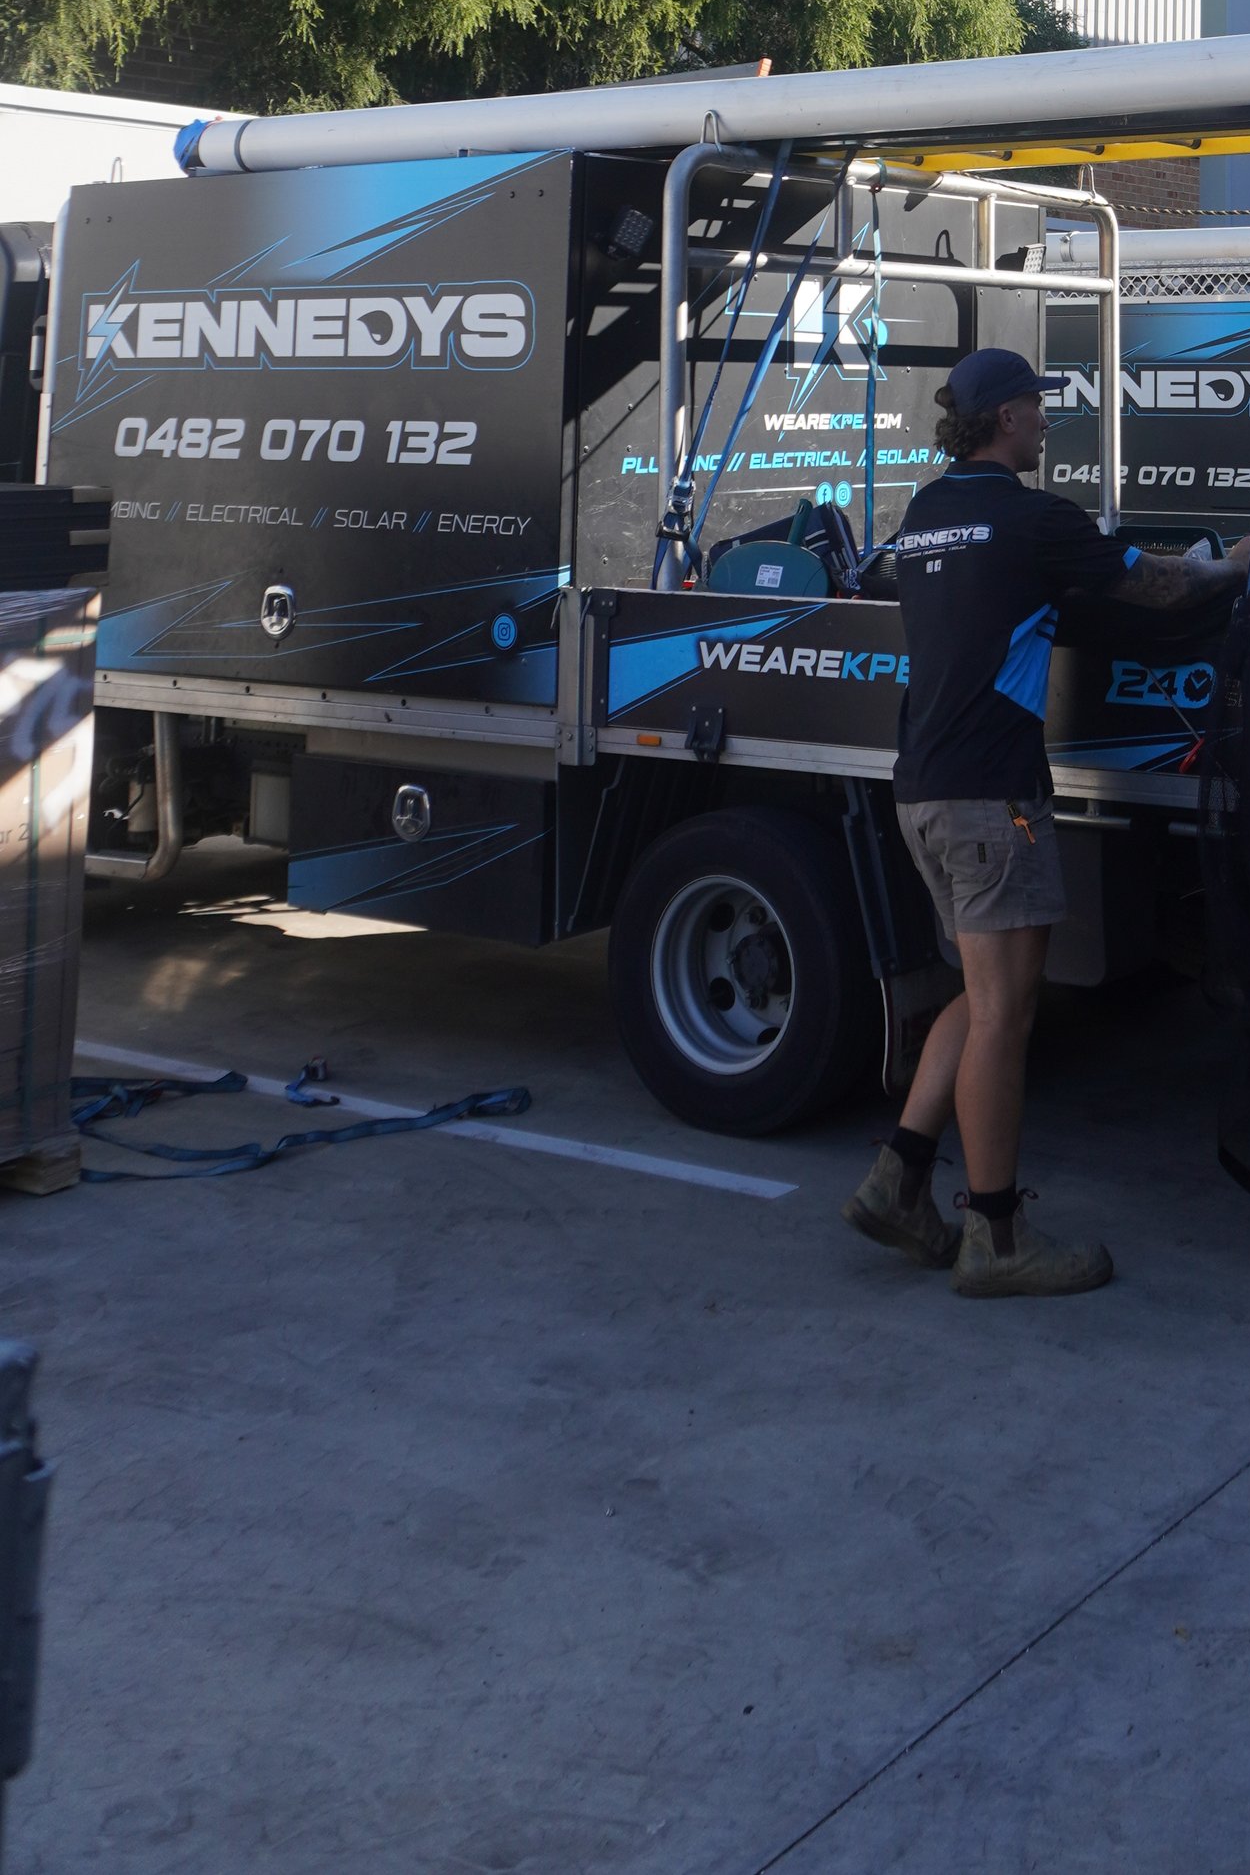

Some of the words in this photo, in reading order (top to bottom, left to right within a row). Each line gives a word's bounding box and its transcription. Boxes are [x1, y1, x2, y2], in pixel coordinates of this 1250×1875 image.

[84, 291, 528, 361] KENNEDYS
[114, 417, 245, 459] 0482
[260, 419, 364, 462] 070
[385, 421, 478, 465] 132
[621, 454, 723, 475] PLUING
[748, 451, 852, 470] ELECTRICAL
[876, 449, 930, 465] SOLAR
[1138, 466, 1196, 486] 070
[186, 504, 304, 527] ELECTRICAL
[333, 509, 408, 531] SOLAR
[437, 513, 532, 536] ENERGY
[896, 526, 991, 552] KENNEDYS
[1115, 667, 1179, 700] 24
